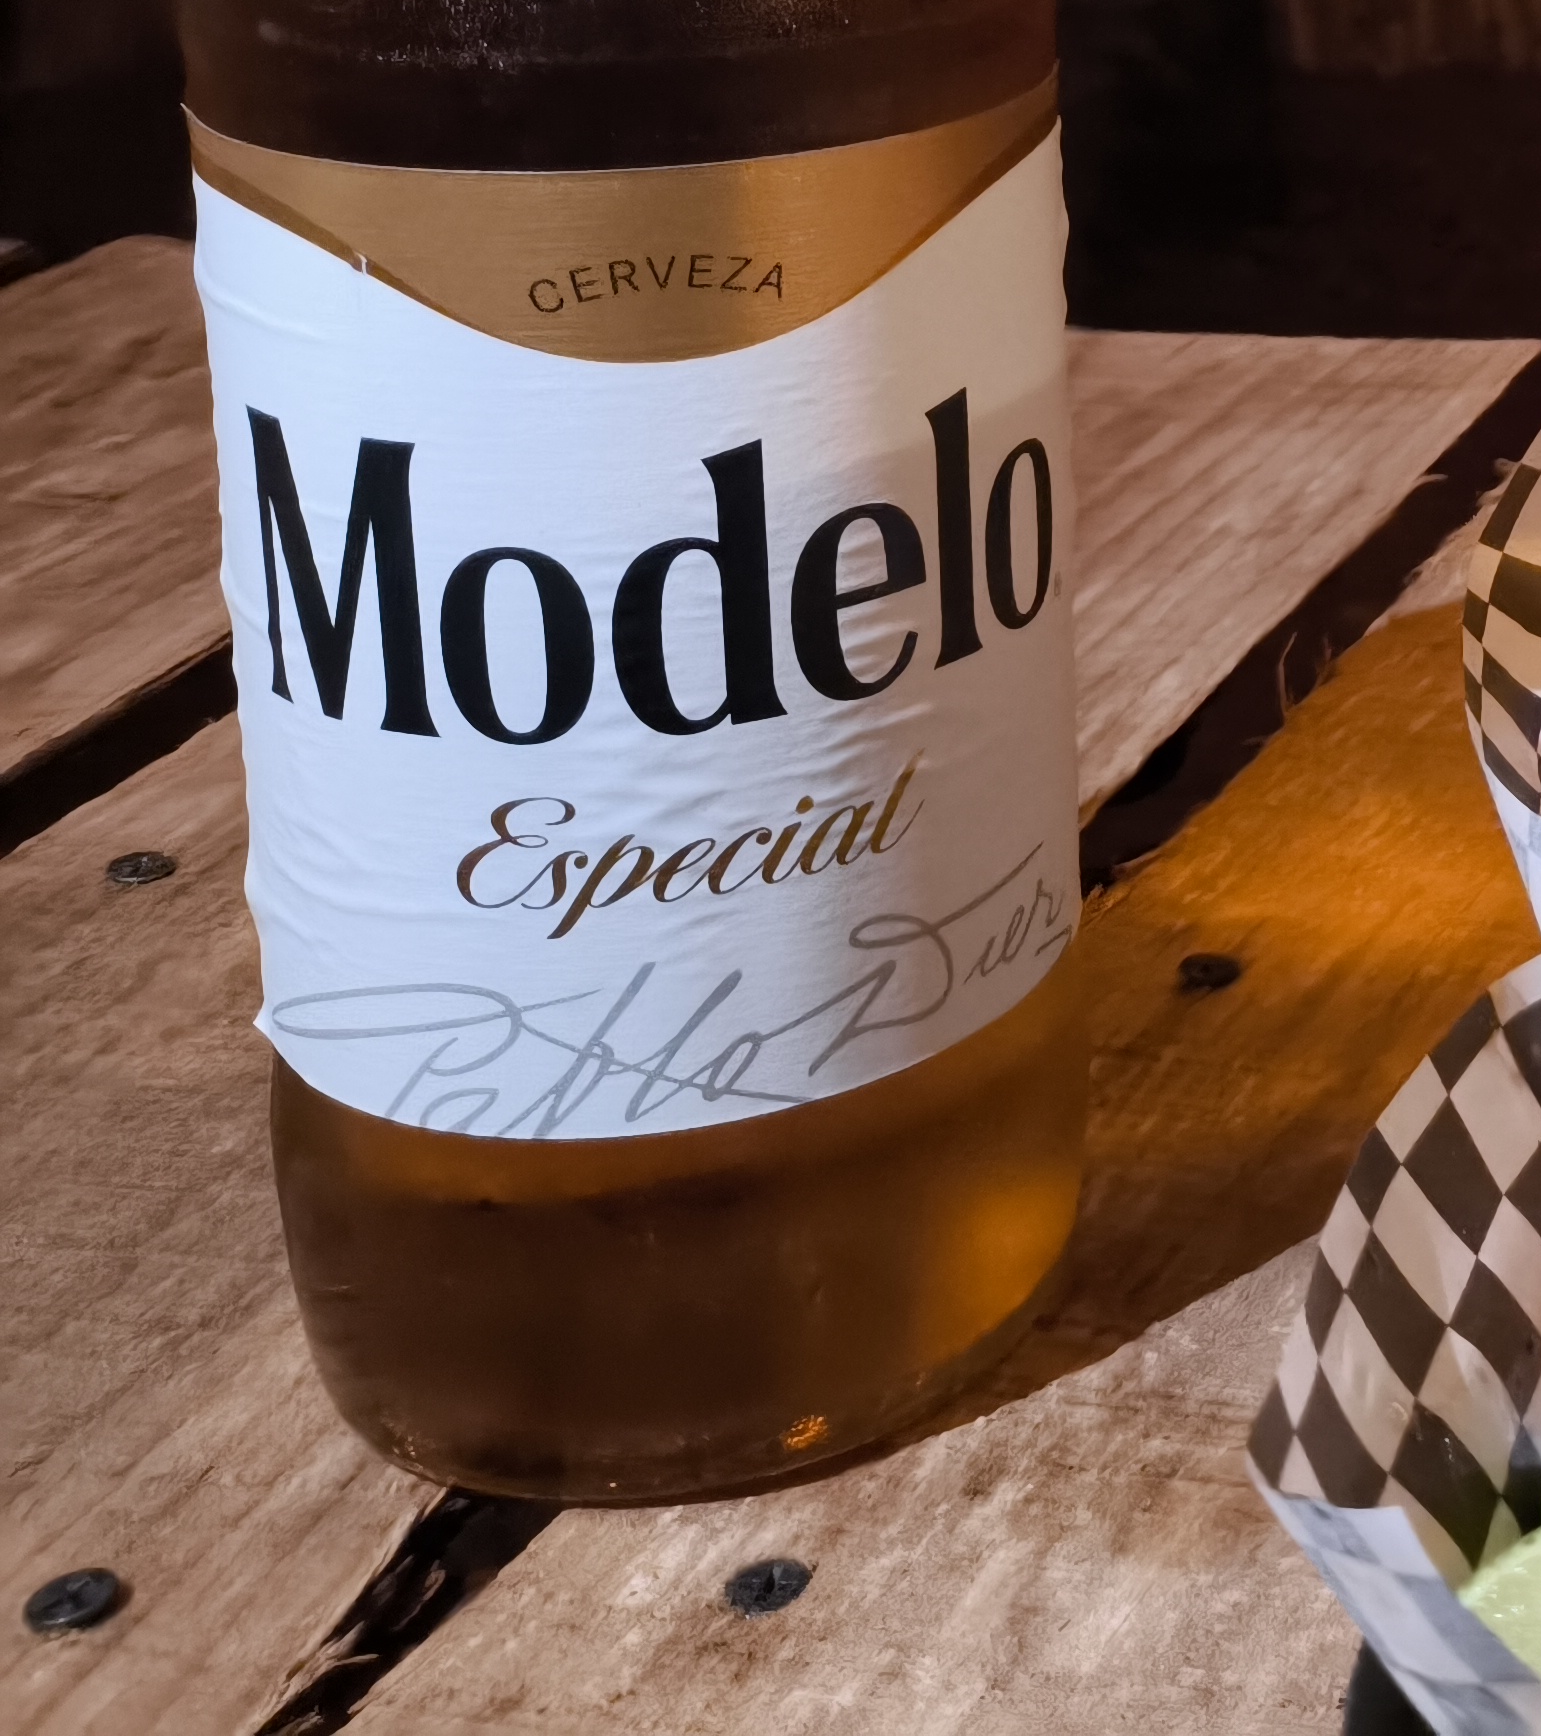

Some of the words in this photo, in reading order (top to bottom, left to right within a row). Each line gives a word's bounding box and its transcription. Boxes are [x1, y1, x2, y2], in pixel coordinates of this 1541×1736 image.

[528, 254, 783, 314] CERVEZA
[246, 387, 1052, 745] Modelo
[456, 748, 925, 940] Especial
